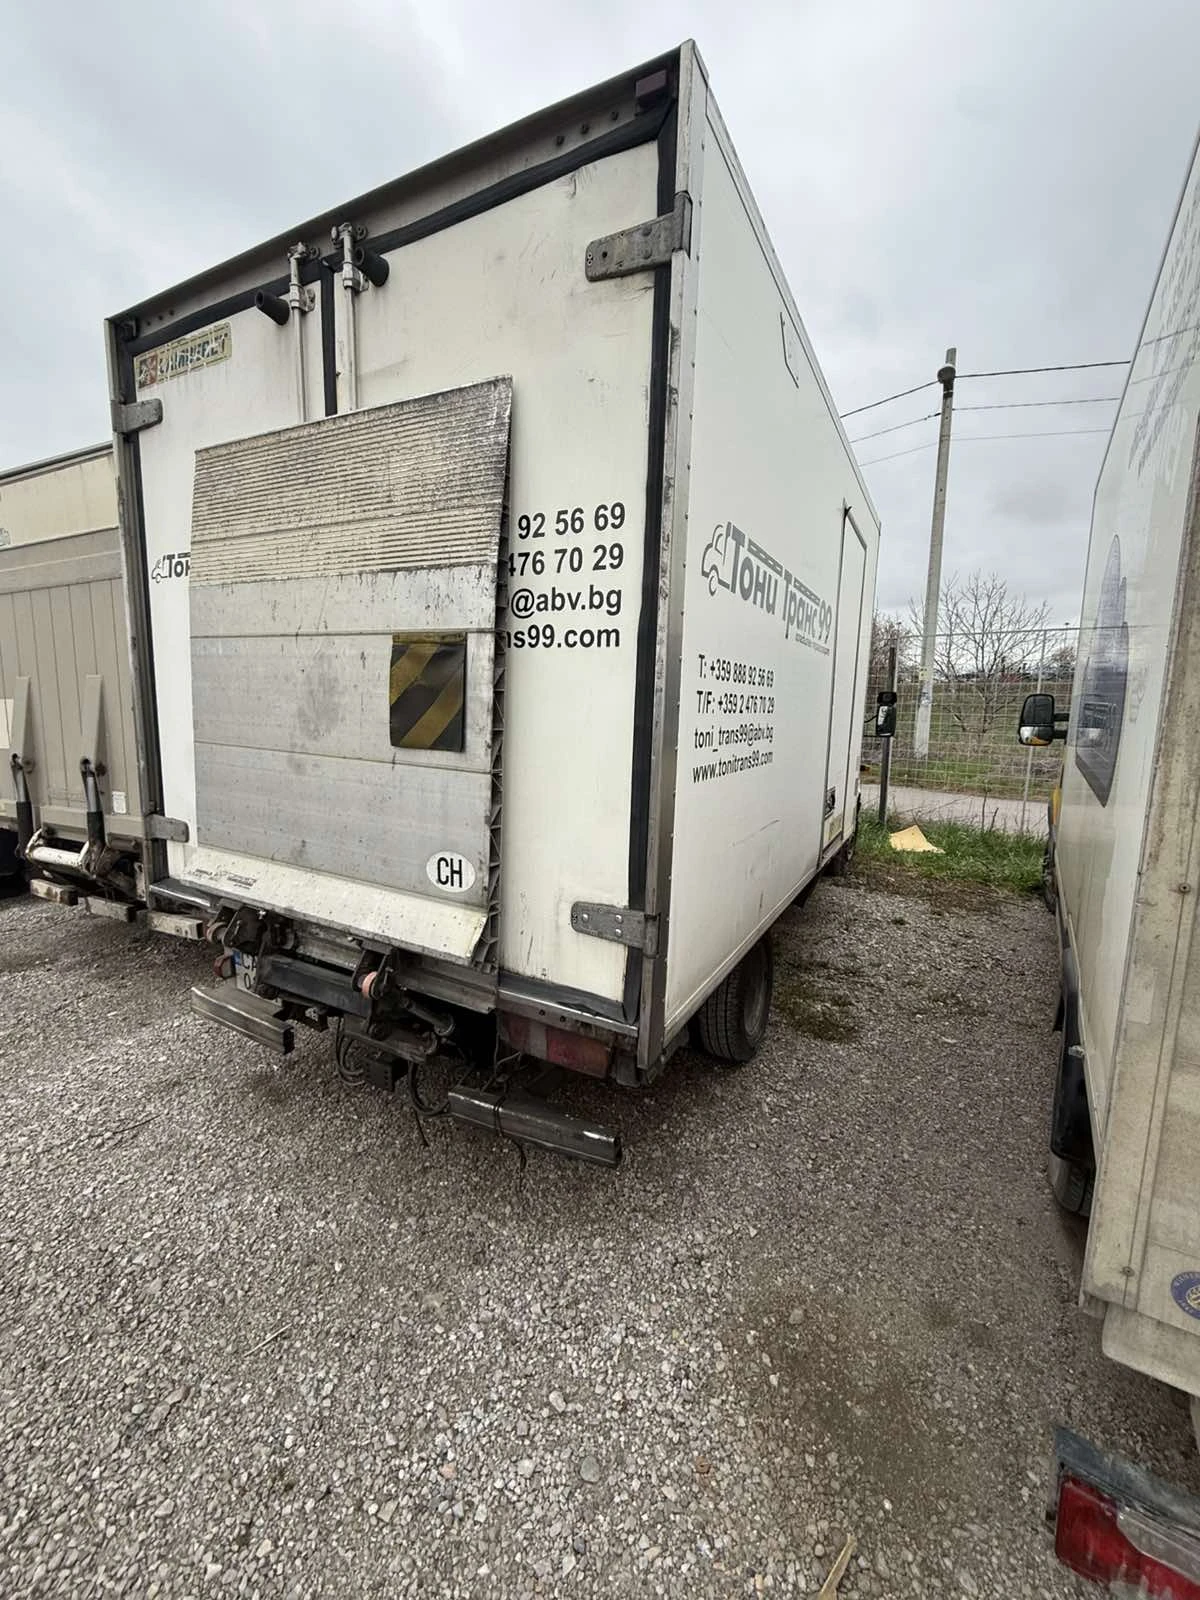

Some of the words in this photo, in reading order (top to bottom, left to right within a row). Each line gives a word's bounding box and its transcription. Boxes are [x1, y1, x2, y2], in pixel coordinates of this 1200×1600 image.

[518, 513, 545, 539] 92
[555, 507, 584, 535] 56
[594, 502, 625, 531] 69
[554, 547, 583, 573] 70
[592, 543, 623, 571] 29
[731, 525, 778, 614] Тони
[511, 584, 622, 619] @abv.bg
[699, 654, 706, 679] T:
[710, 658, 731, 682] +359
[733, 662, 747, 684] 888
[748, 665, 757, 686] 92
[758, 668, 765, 687] 56
[697, 690, 715, 714] T/F:
[718, 693, 737, 714] +359
[739, 694, 744, 714] 2
[746, 695, 758, 714] 476
[695, 723, 773, 752] toni_trans99@abv.bg
[693, 750, 773, 783] www.tonitrans99.com
[437, 857, 462, 888] CH
